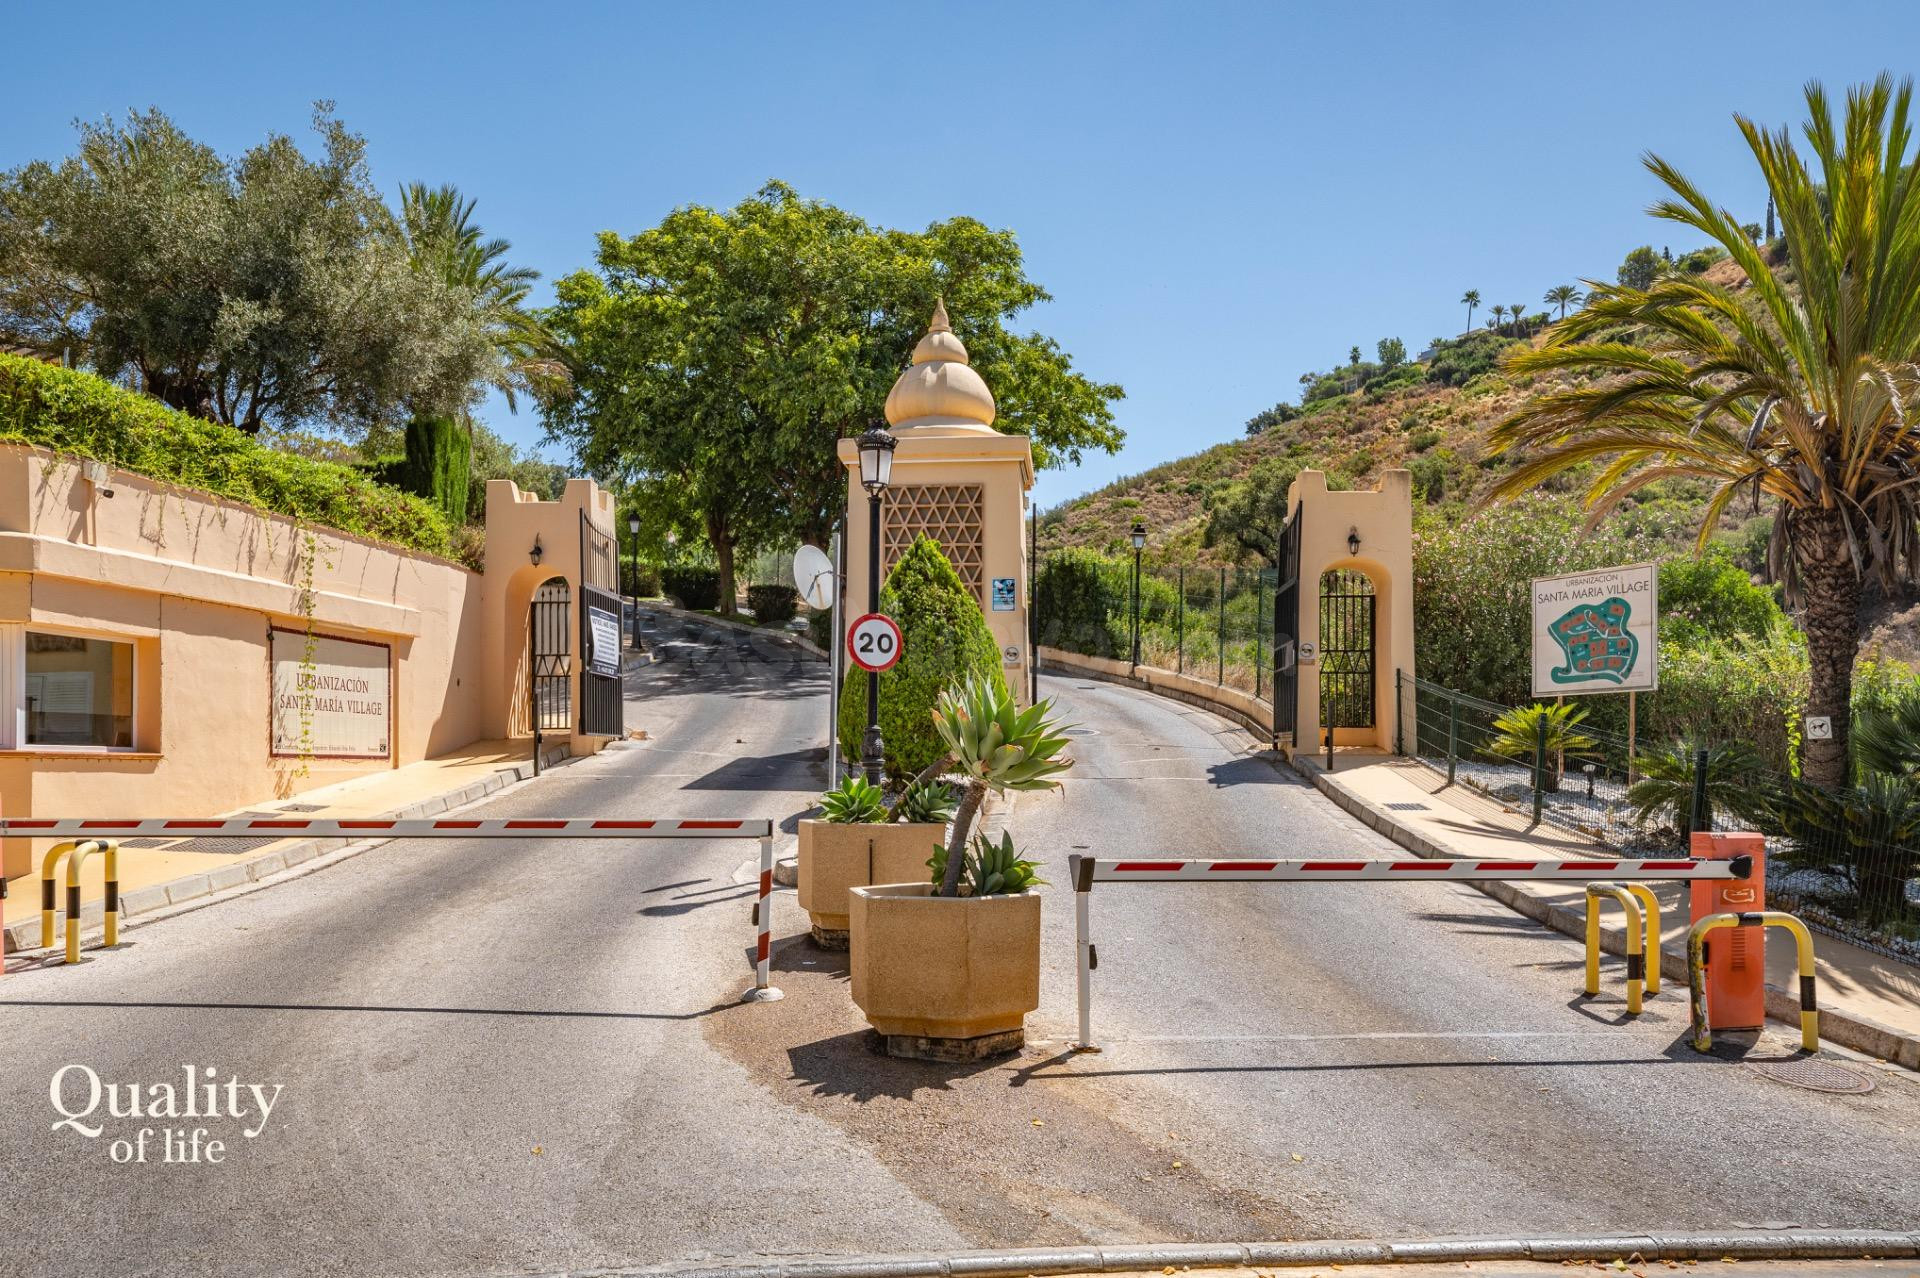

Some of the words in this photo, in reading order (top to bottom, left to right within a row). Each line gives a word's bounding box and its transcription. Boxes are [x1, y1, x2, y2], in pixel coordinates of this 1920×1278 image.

[1537, 591, 1569, 604] SANTA
[1571, 587, 1604, 600] MARIA
[1606, 580, 1649, 594] VILLAGE
[858, 632, 894, 654] 20
[315, 696, 344, 713] MARÍA
[346, 700, 383, 715] VILLAGE
